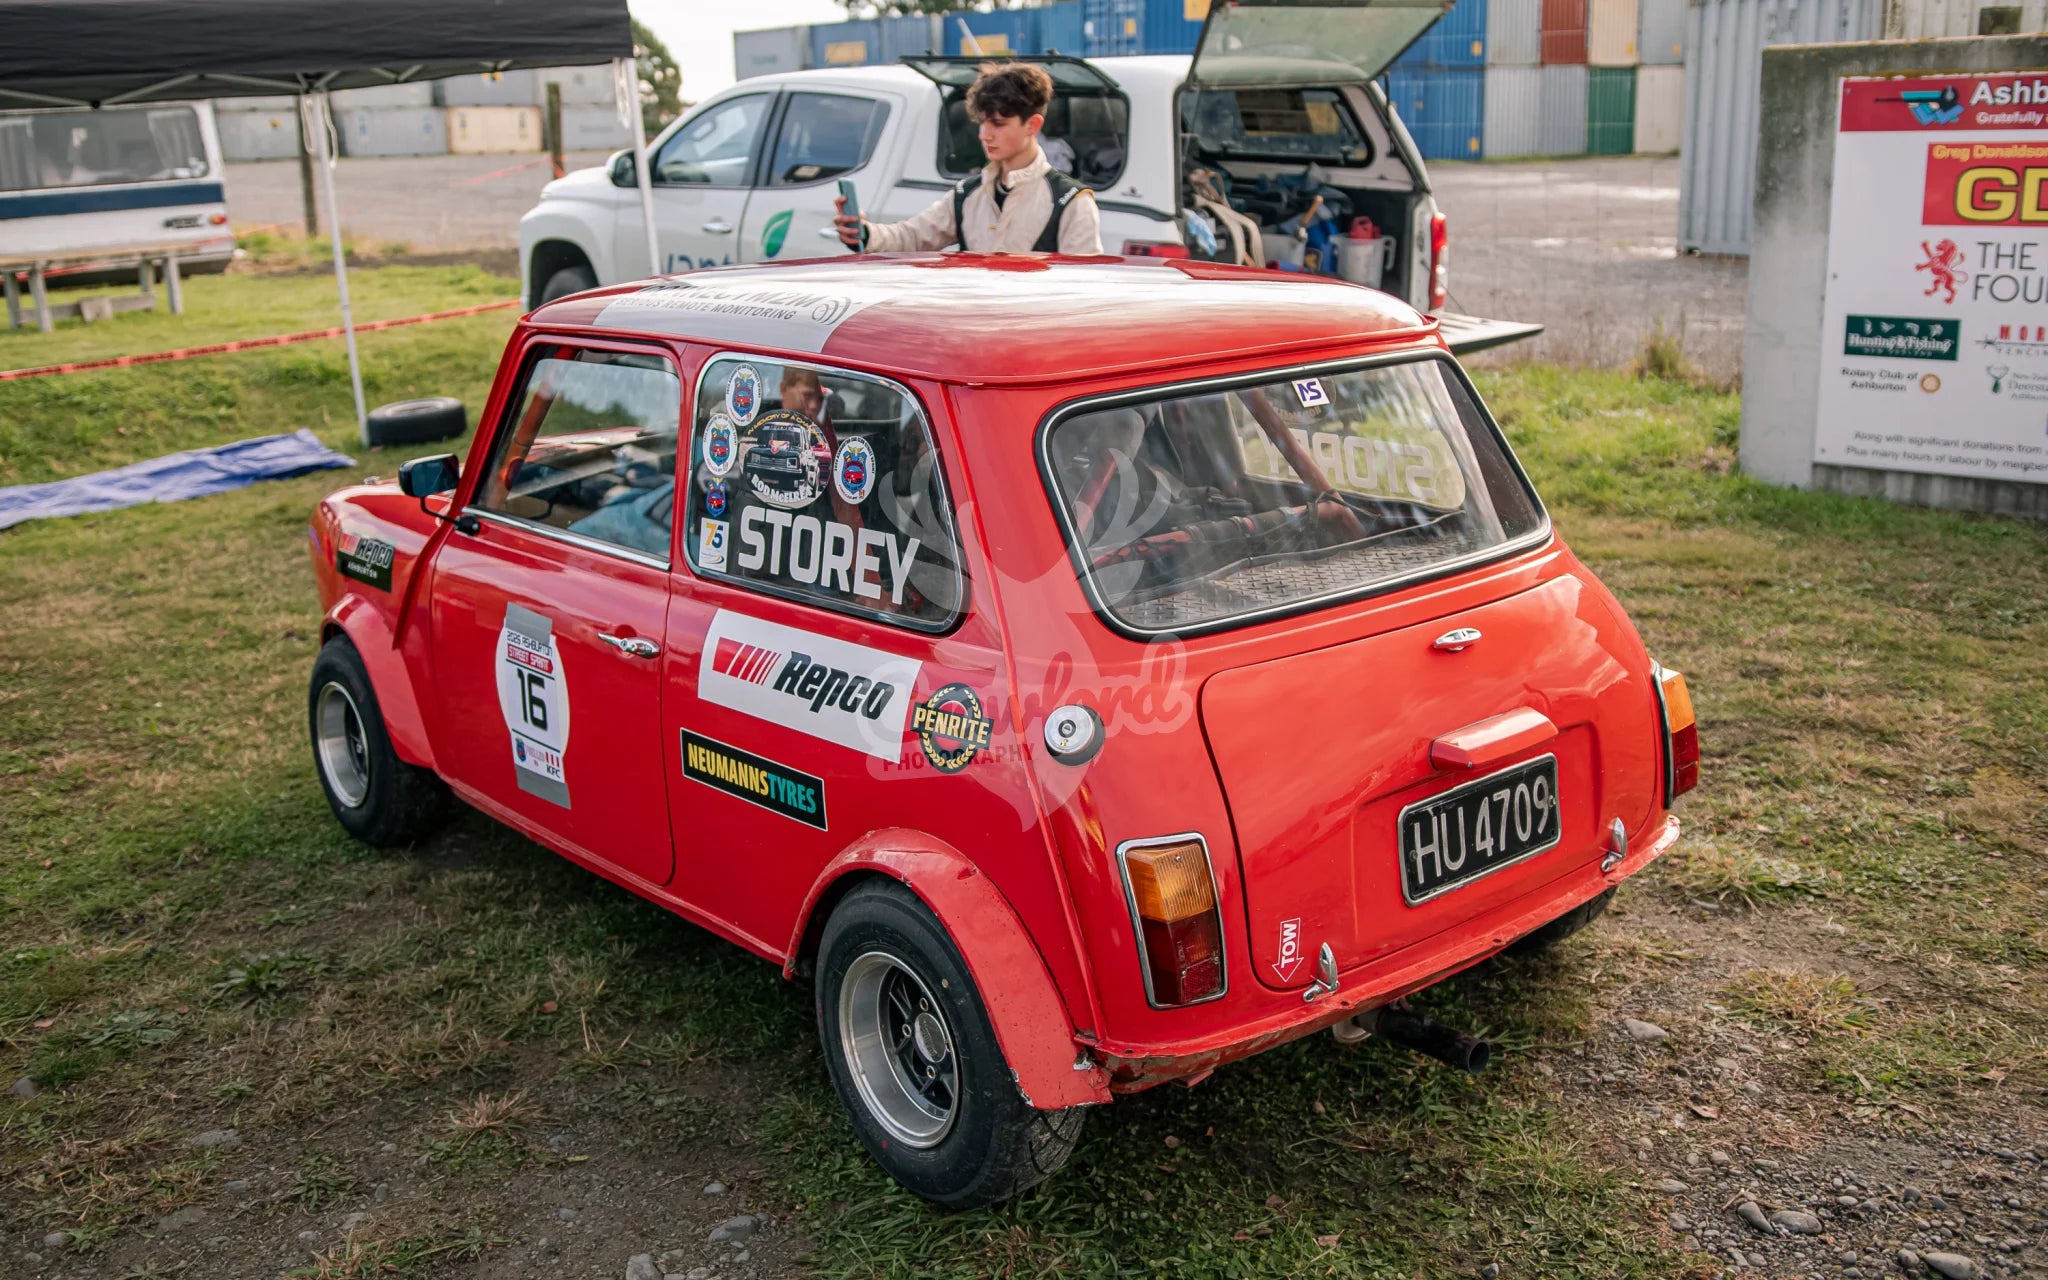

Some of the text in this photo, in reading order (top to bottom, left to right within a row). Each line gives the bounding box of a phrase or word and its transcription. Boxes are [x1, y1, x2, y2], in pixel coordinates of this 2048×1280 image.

[1969, 80, 2048, 106] Ashb
[1976, 111, 2043, 126] Gratefully
[1932, 144, 1970, 162] Greg
[1976, 241, 2039, 271] THE
[663, 300, 713, 313] REMOTE
[710, 303, 797, 320] MONITORING
[1854, 430, 1882, 443] Along
[1908, 435, 1960, 449] significant
[1962, 440, 2017, 453] donations
[751, 473, 771, 496] ROD
[705, 522, 724, 549] 75
[355, 537, 396, 569] Repco
[738, 505, 920, 605] STOREY
[772, 650, 895, 721] Repco
[517, 668, 549, 732] 16
[913, 705, 990, 746] PENRITE
[546, 763, 561, 779] KFC
[1414, 774, 1550, 885] HU 4709
[1280, 923, 1297, 969] TOW
